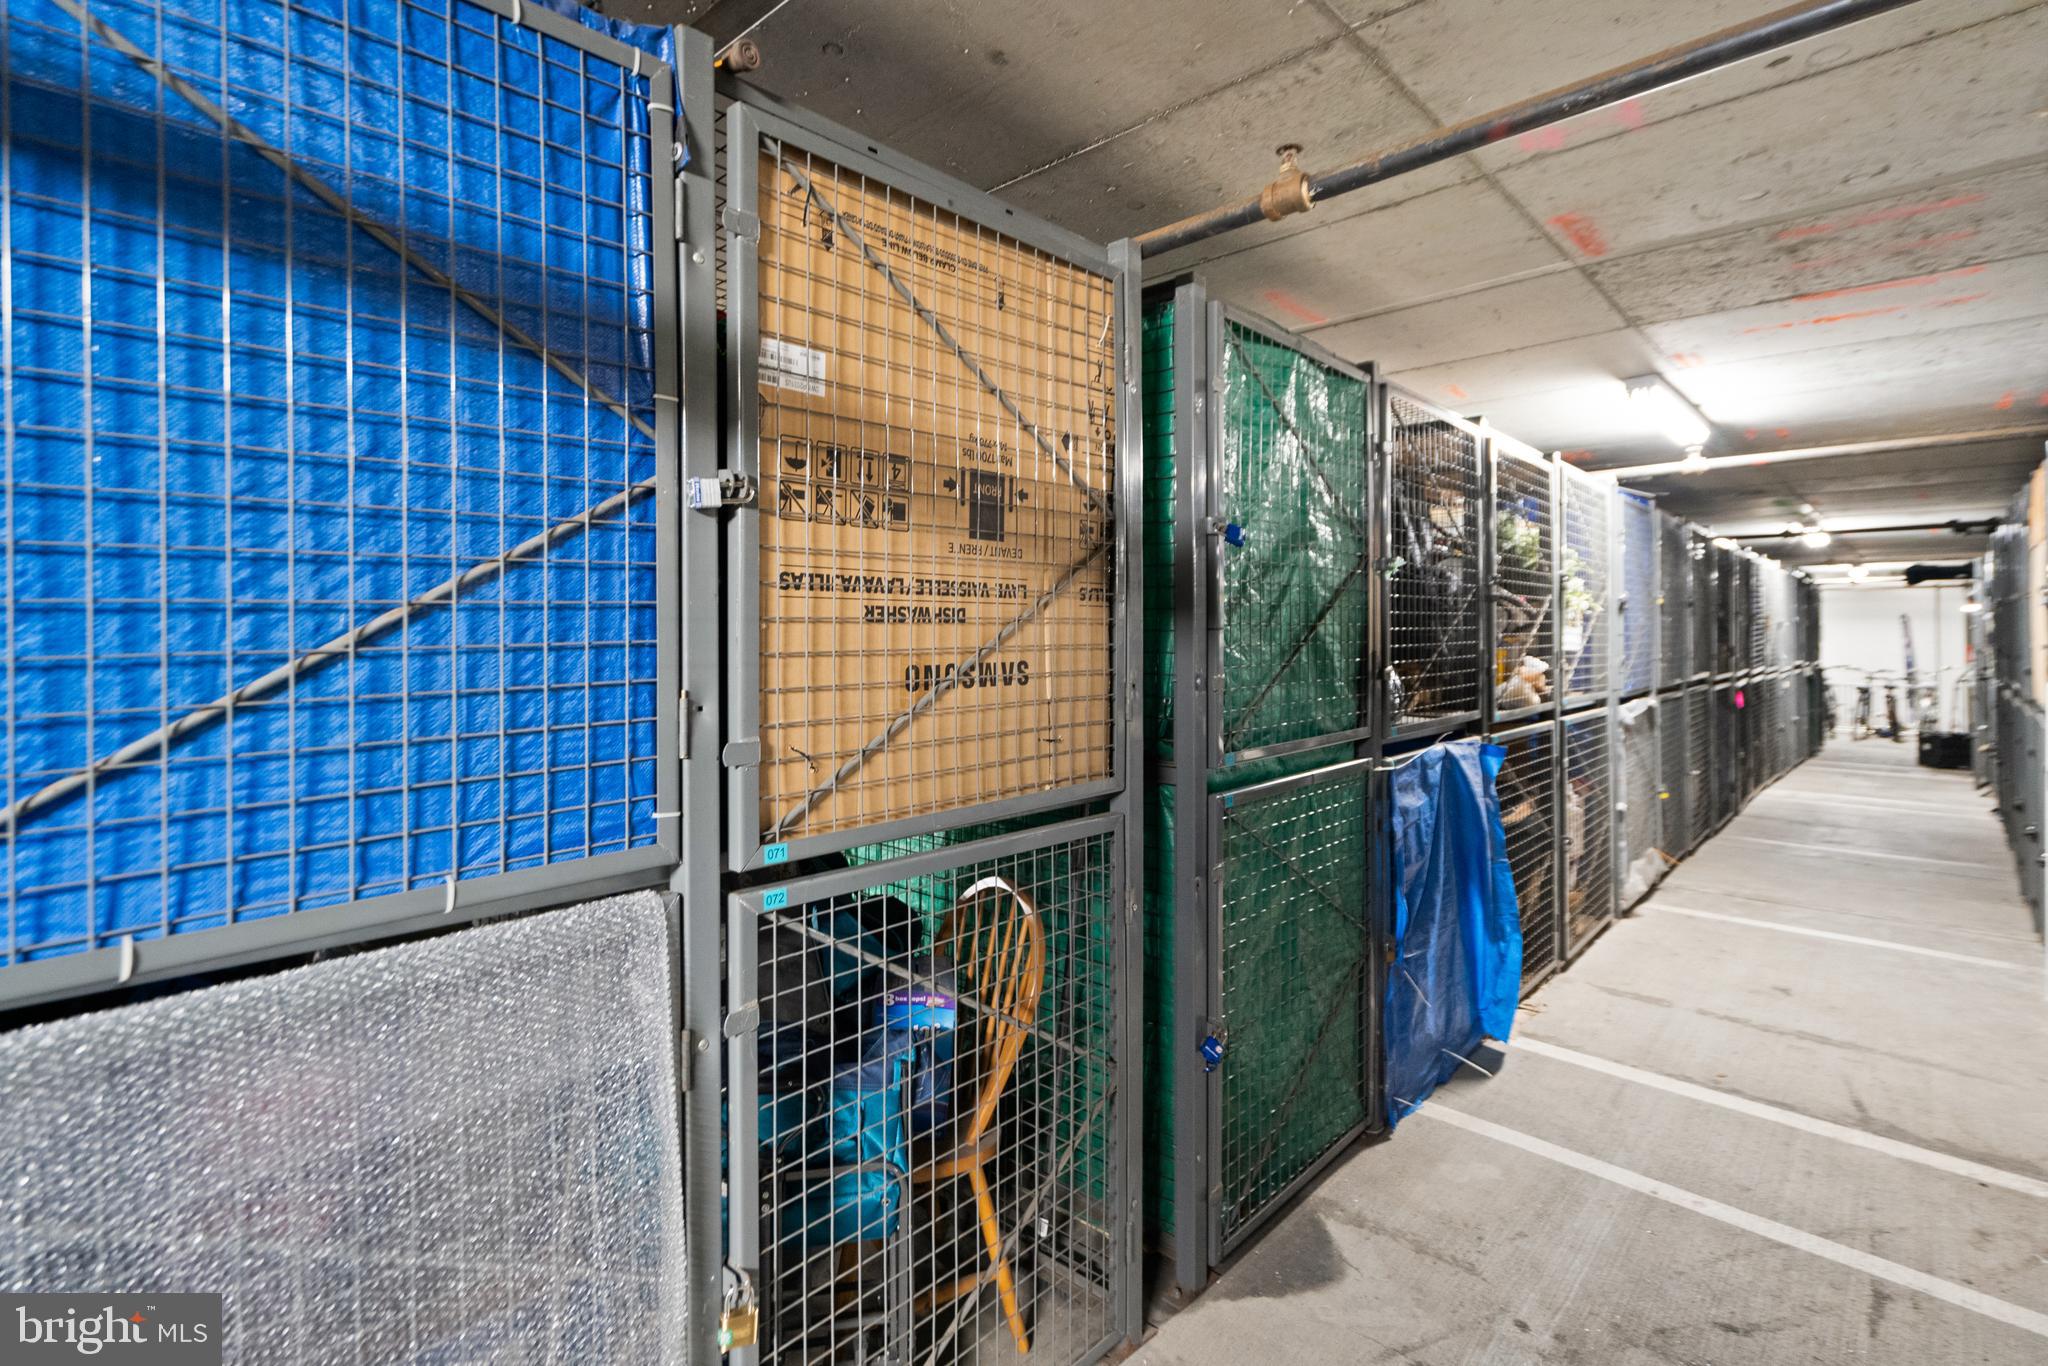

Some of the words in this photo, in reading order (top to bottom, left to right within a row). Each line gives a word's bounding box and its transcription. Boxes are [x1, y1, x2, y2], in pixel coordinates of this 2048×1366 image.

[962, 447, 975, 460] lbs
[973, 483, 1003, 497] FRONT
[989, 546, 1023, 559] DEVANT
[905, 660, 1029, 693] SAMSUNG
[767, 847, 785, 860] 071
[766, 892, 785, 906] 072
[909, 995, 926, 1003] ops!
